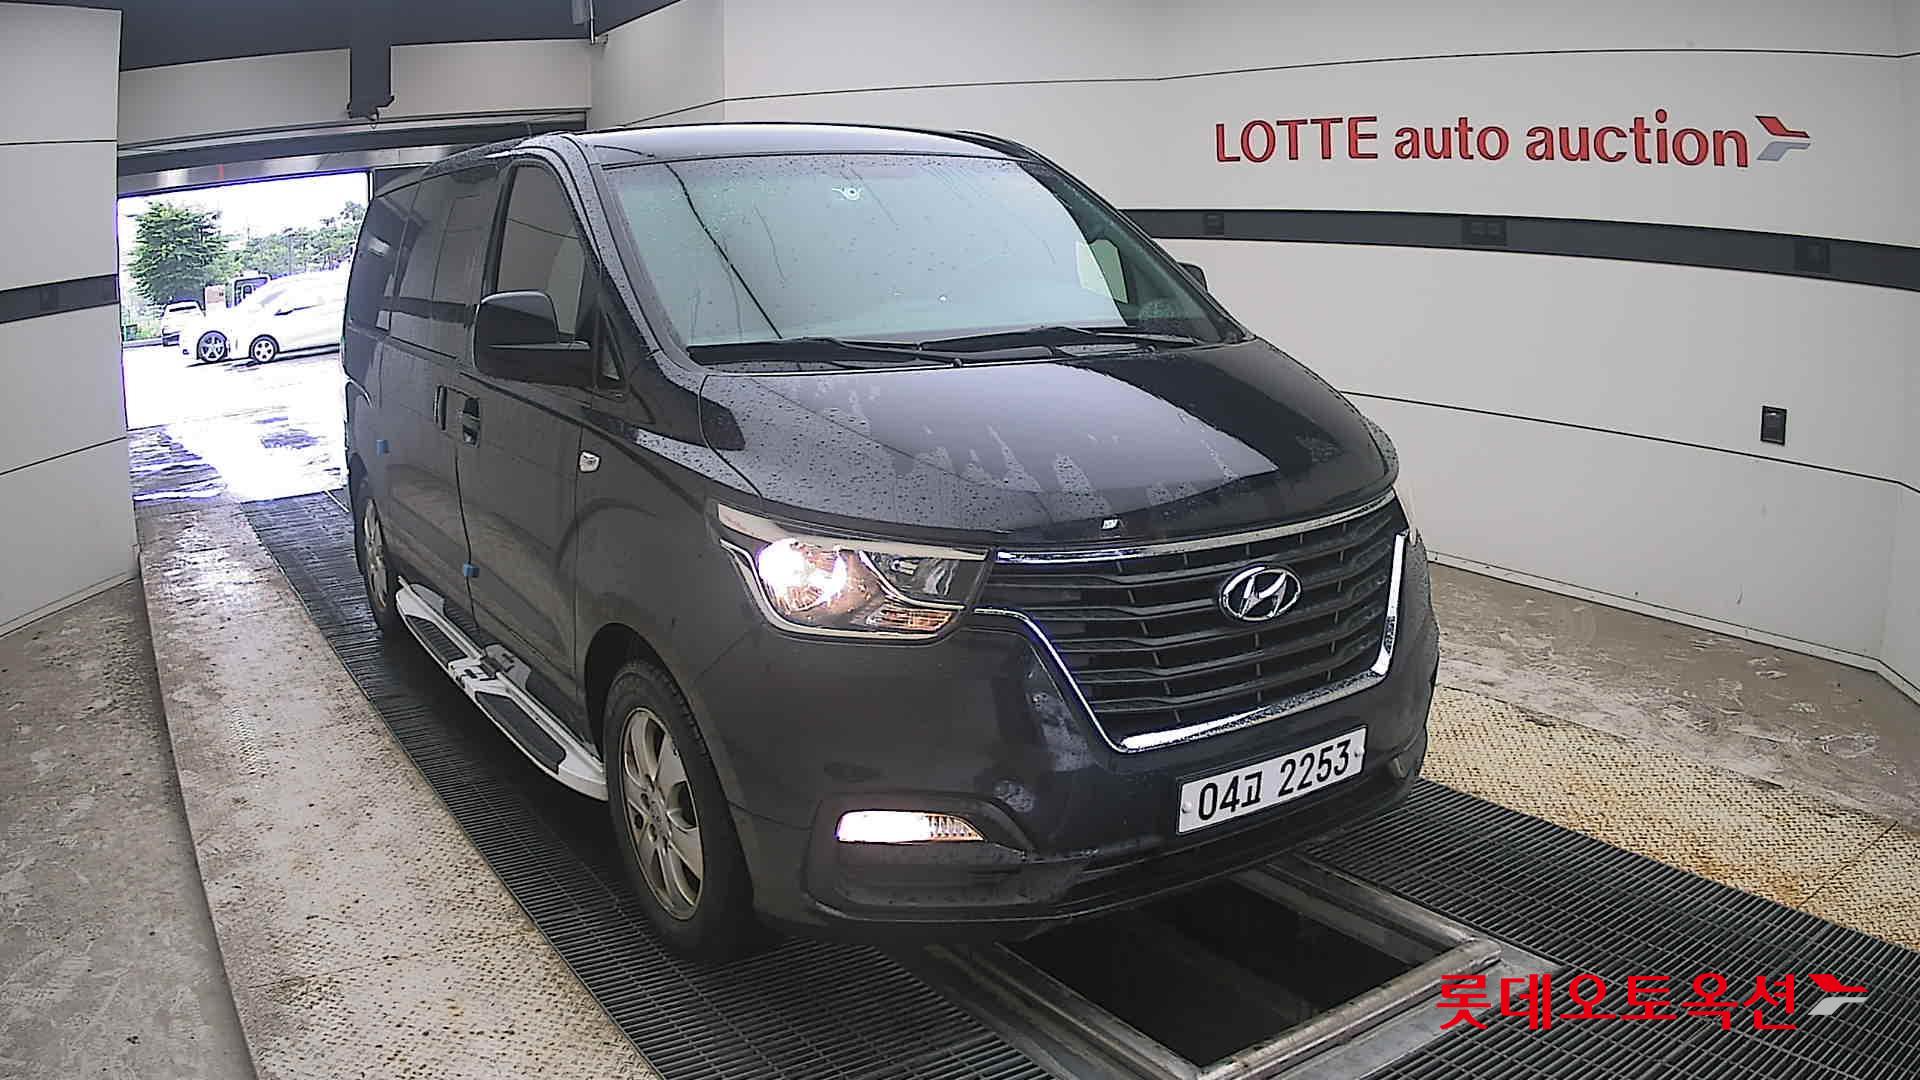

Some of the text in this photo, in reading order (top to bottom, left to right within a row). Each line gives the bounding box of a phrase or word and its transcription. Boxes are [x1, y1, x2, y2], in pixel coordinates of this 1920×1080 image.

[1215, 109, 1750, 168] LOTTE auto auction
[1198, 739, 1352, 821] 04고 2253
